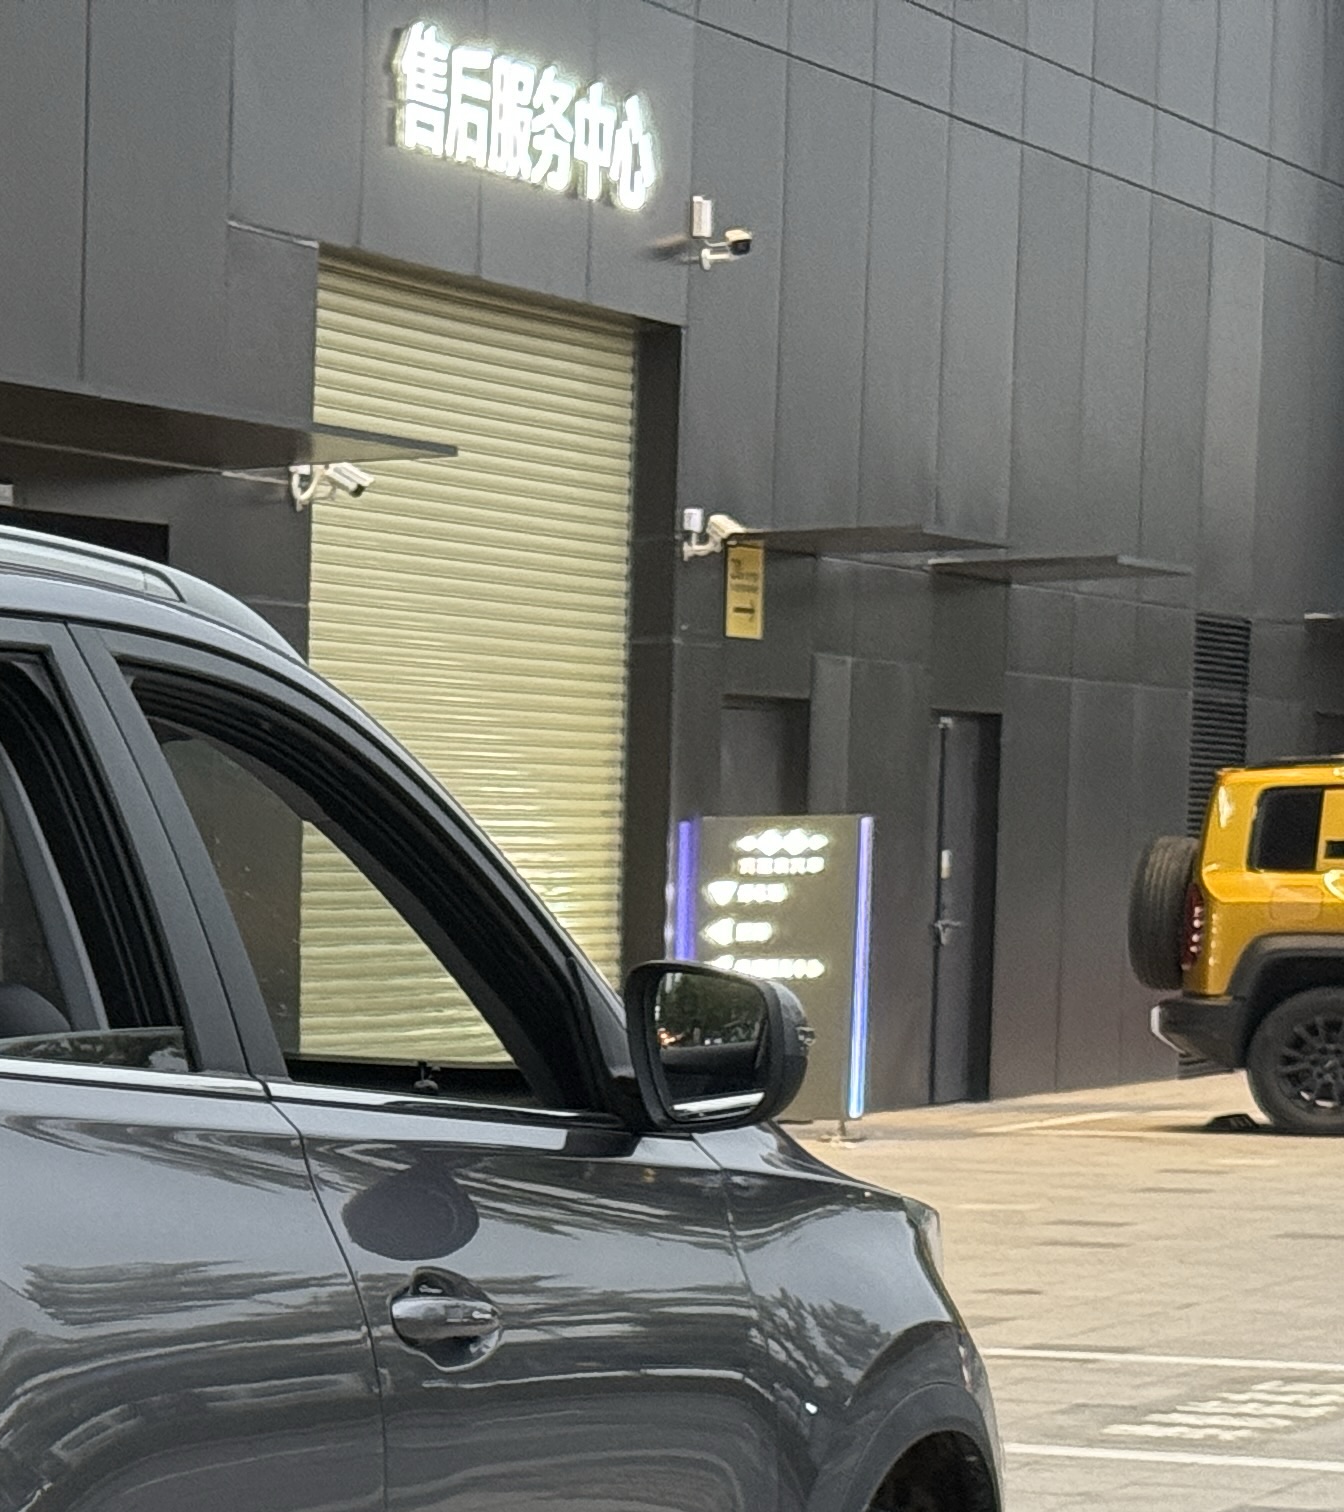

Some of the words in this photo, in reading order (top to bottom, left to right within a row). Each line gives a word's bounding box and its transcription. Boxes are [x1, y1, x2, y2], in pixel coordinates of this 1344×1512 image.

[400, 20, 655, 210] 售后服务中心
